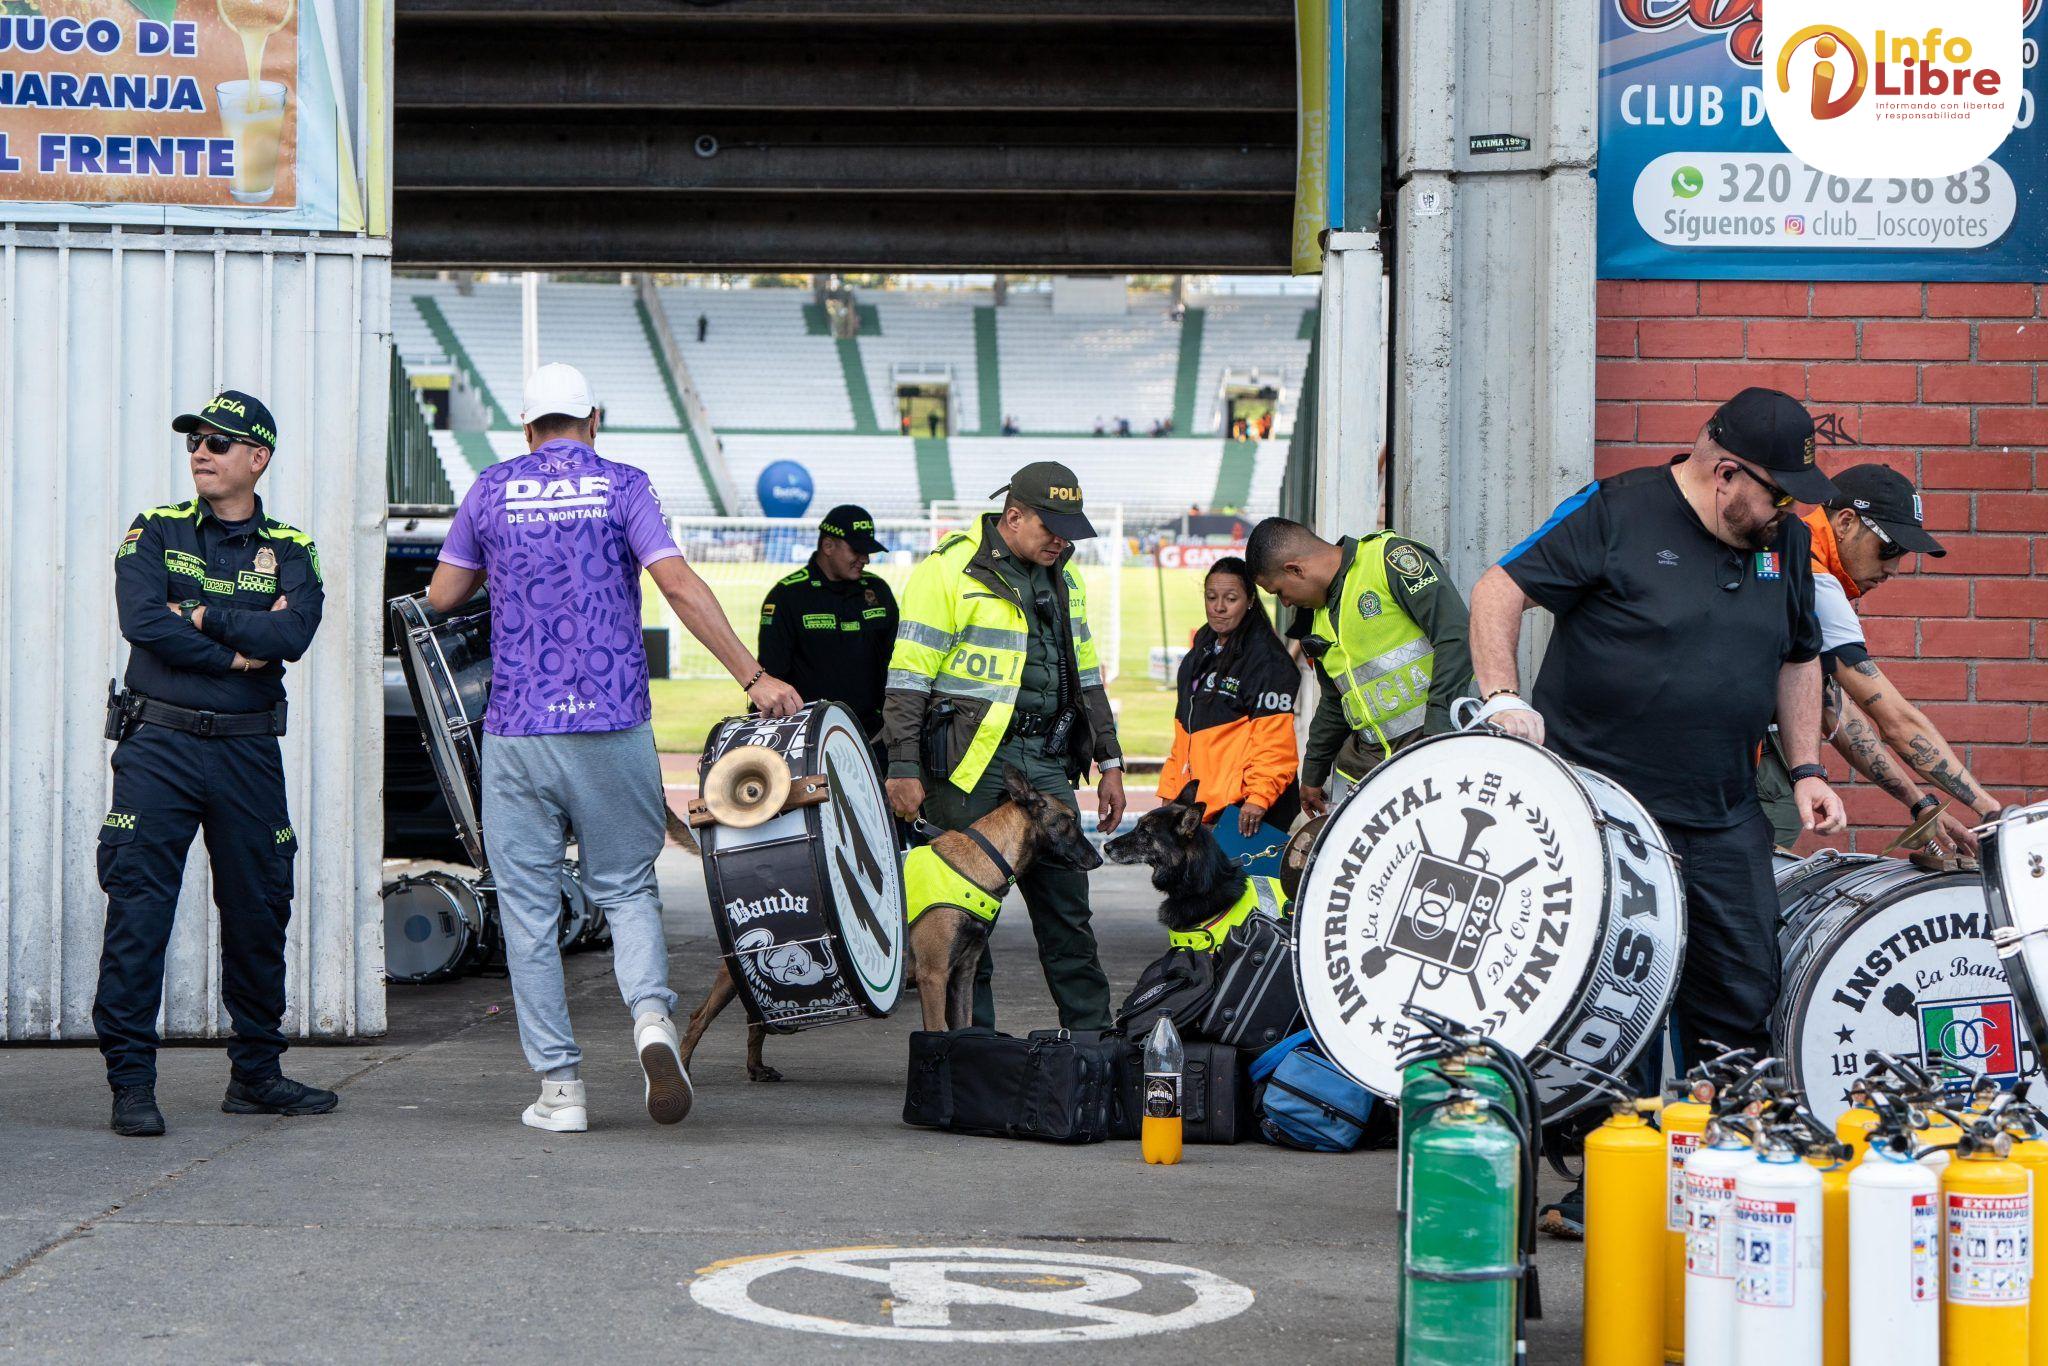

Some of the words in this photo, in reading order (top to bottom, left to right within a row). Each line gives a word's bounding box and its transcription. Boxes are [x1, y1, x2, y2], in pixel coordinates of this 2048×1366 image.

[139, 21, 197, 55] DE
[1620, 84, 1724, 126] CLUB
[1741, 85, 1766, 127] D
[40, 135, 235, 177] FRENTE
[1470, 138, 1504, 149] FATIMA
[1718, 162, 1791, 203] 320
[1803, 163, 1873, 204] 762
[1945, 165, 1991, 205] 83
[1663, 208, 1775, 241] Síguenos
[1812, 210, 1988, 243] club_loscoyotes
[505, 476, 611, 499] DAF
[507, 513, 524, 524] DE
[528, 512, 544, 523] LA
[549, 508, 608, 522] MONTAÑA
[1367, 840, 1416, 906] Banda
[725, 888, 809, 927] Banda
[1324, 777, 1443, 1025] INSTRUMENTAL
[1361, 911, 1379, 942] La
[1460, 895, 1493, 949] 1948
[1487, 942, 1517, 986] Del
[1510, 887, 1532, 940] Once
[1916, 969, 1944, 993] La
[1831, 1052, 1858, 1077] 19
